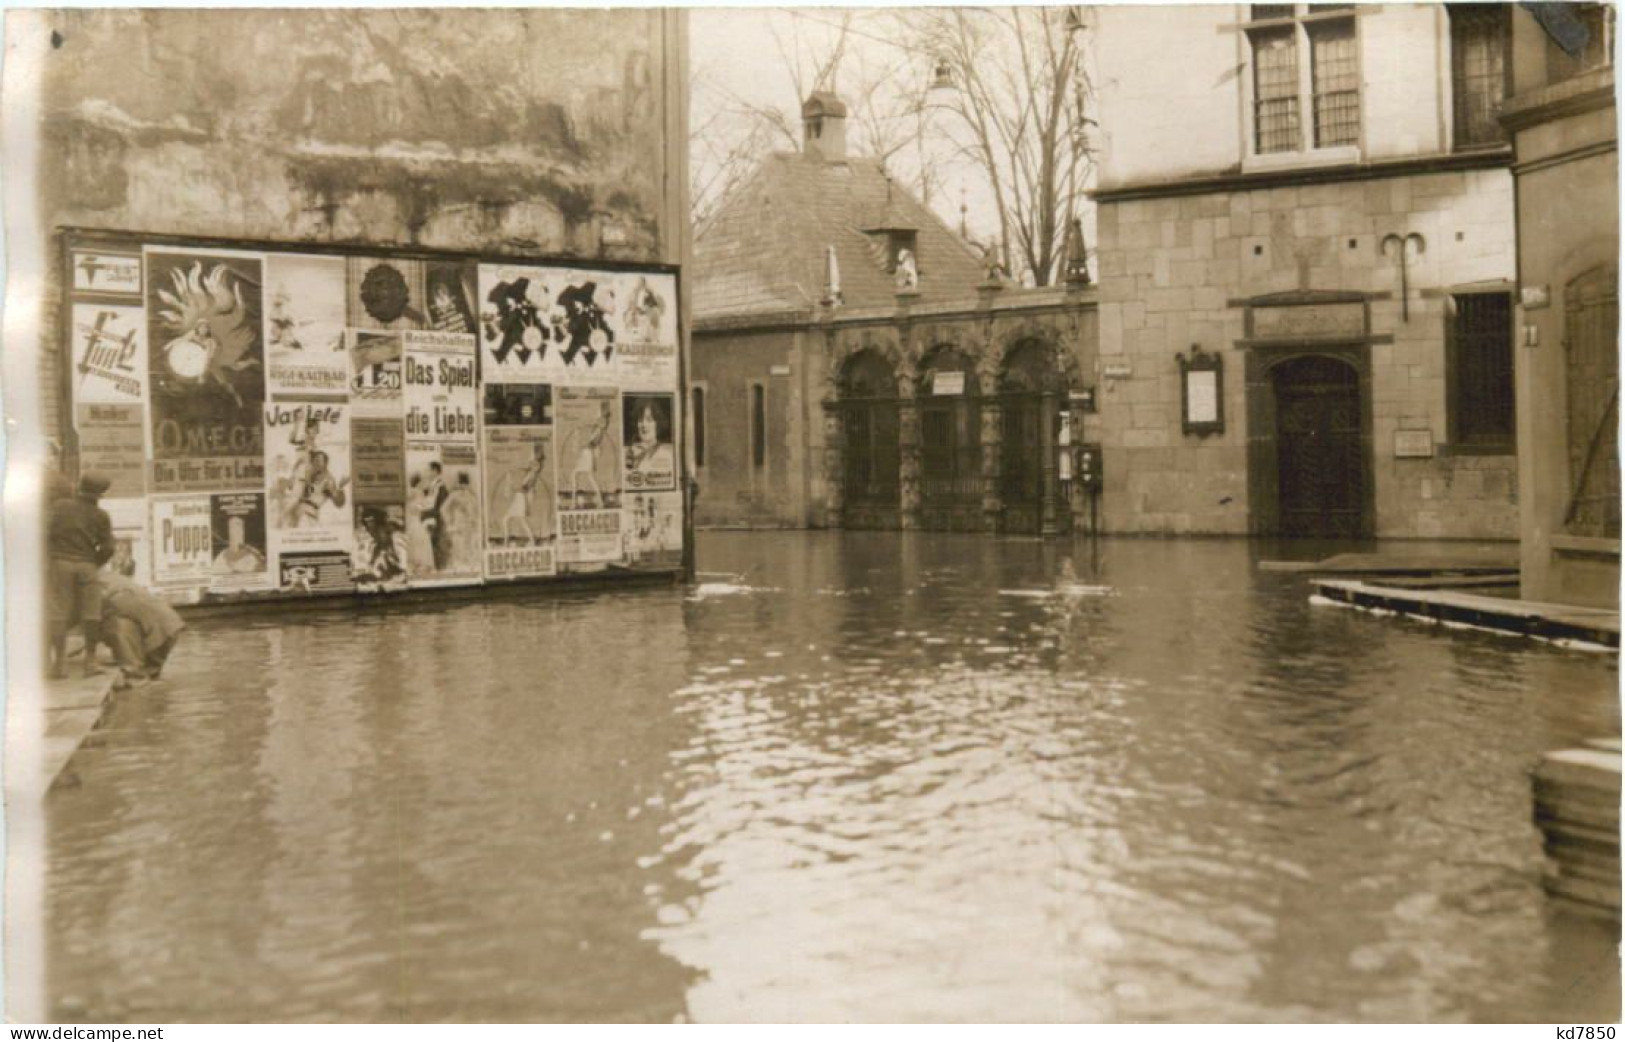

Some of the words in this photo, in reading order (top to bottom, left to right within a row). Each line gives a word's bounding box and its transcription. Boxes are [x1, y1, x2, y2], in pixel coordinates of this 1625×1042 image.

[406, 356, 434, 385] Das
[439, 359, 472, 392] Spiel
[406, 406, 429, 434] die
[435, 406, 474, 434] Liebe
[562, 512, 620, 534] BOCCACCIO
[163, 518, 209, 560] Puppe
[490, 550, 551, 571] BOCCACCIO
